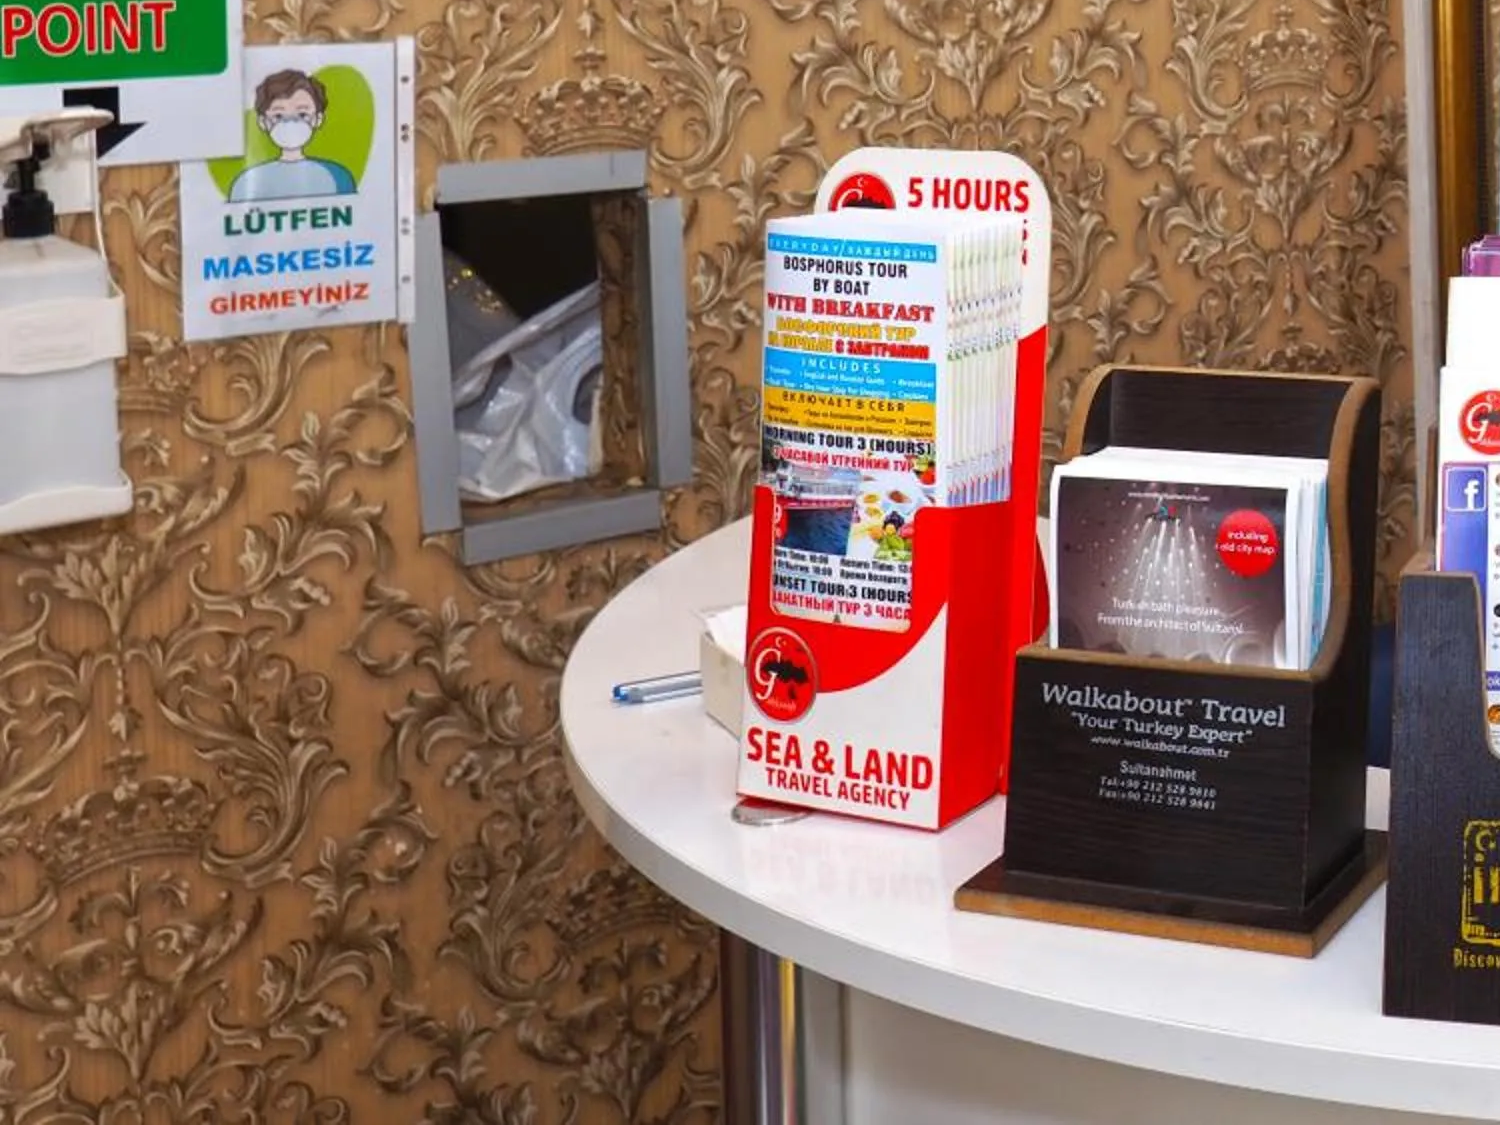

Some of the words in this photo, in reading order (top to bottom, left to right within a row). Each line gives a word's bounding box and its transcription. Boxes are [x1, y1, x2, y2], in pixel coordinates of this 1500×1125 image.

[908, 176, 923, 209] 5
[932, 177, 1030, 214] HOURS
[223, 203, 355, 238] LÜTFEN
[202, 242, 376, 281] MASKESİZ
[783, 255, 864, 276] BOSPHORUS
[869, 262, 908, 278] TOUR
[208, 281, 372, 316] GİRMEYİNİZ
[813, 278, 829, 292] BY
[834, 281, 870, 296] BOAT
[812, 296, 935, 322] BREAKFAST
[801, 357, 882, 375] INCLUDES
[819, 433, 853, 451] TOUR
[857, 437, 866, 450] 3
[1042, 683, 1185, 718] Walkabout
[1200, 698, 1287, 728] Travel
[1123, 717, 1185, 740] Turkey
[746, 726, 803, 770] SEA
[811, 739, 836, 776] &
[844, 744, 934, 791] LAND
[765, 767, 833, 798] TRAVEL
[838, 781, 911, 812] AGENCY
